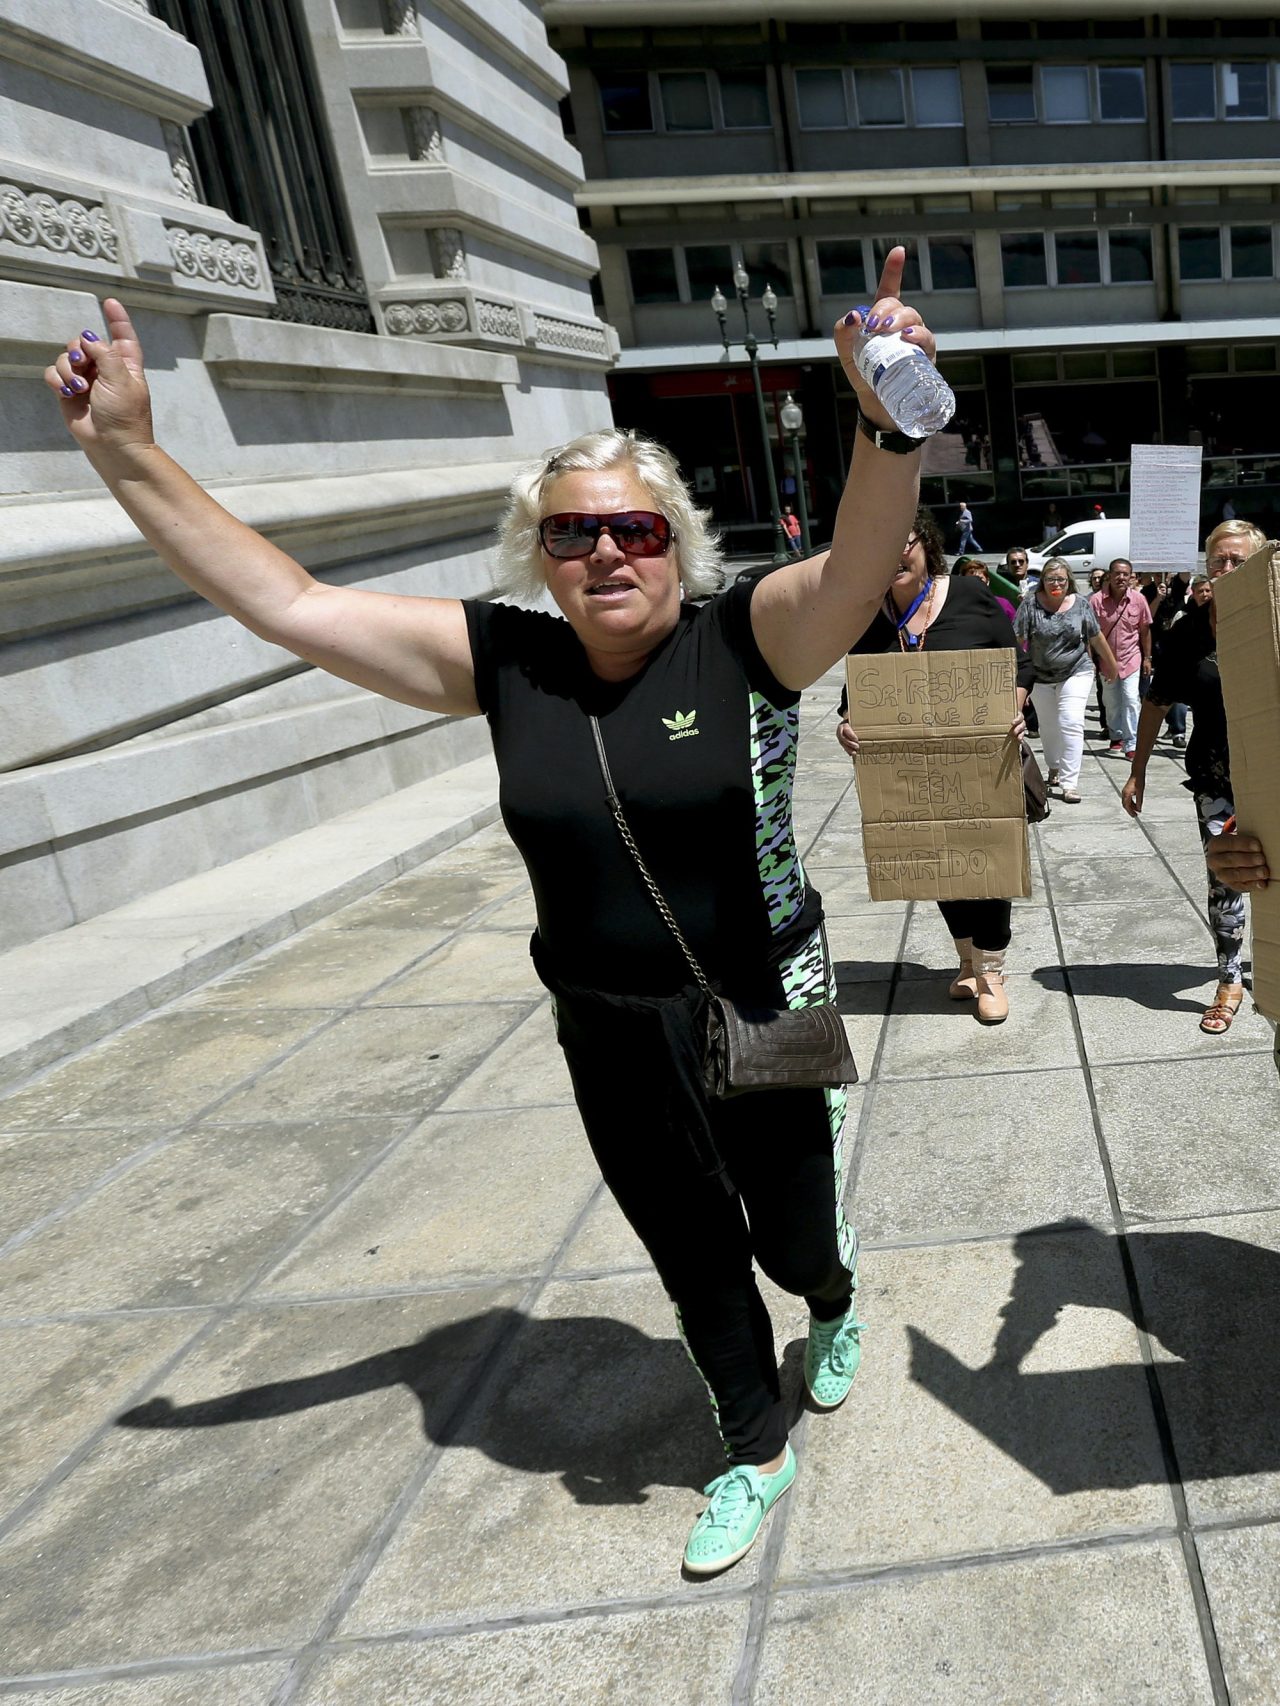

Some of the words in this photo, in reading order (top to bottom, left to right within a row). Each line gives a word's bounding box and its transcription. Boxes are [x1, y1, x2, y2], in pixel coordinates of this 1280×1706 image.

[897, 711, 913, 726] O
[921, 707, 961, 727] QUE
[668, 727, 700, 741] adidas
[879, 809, 931, 832] QUE
[940, 802, 992, 831] SER
